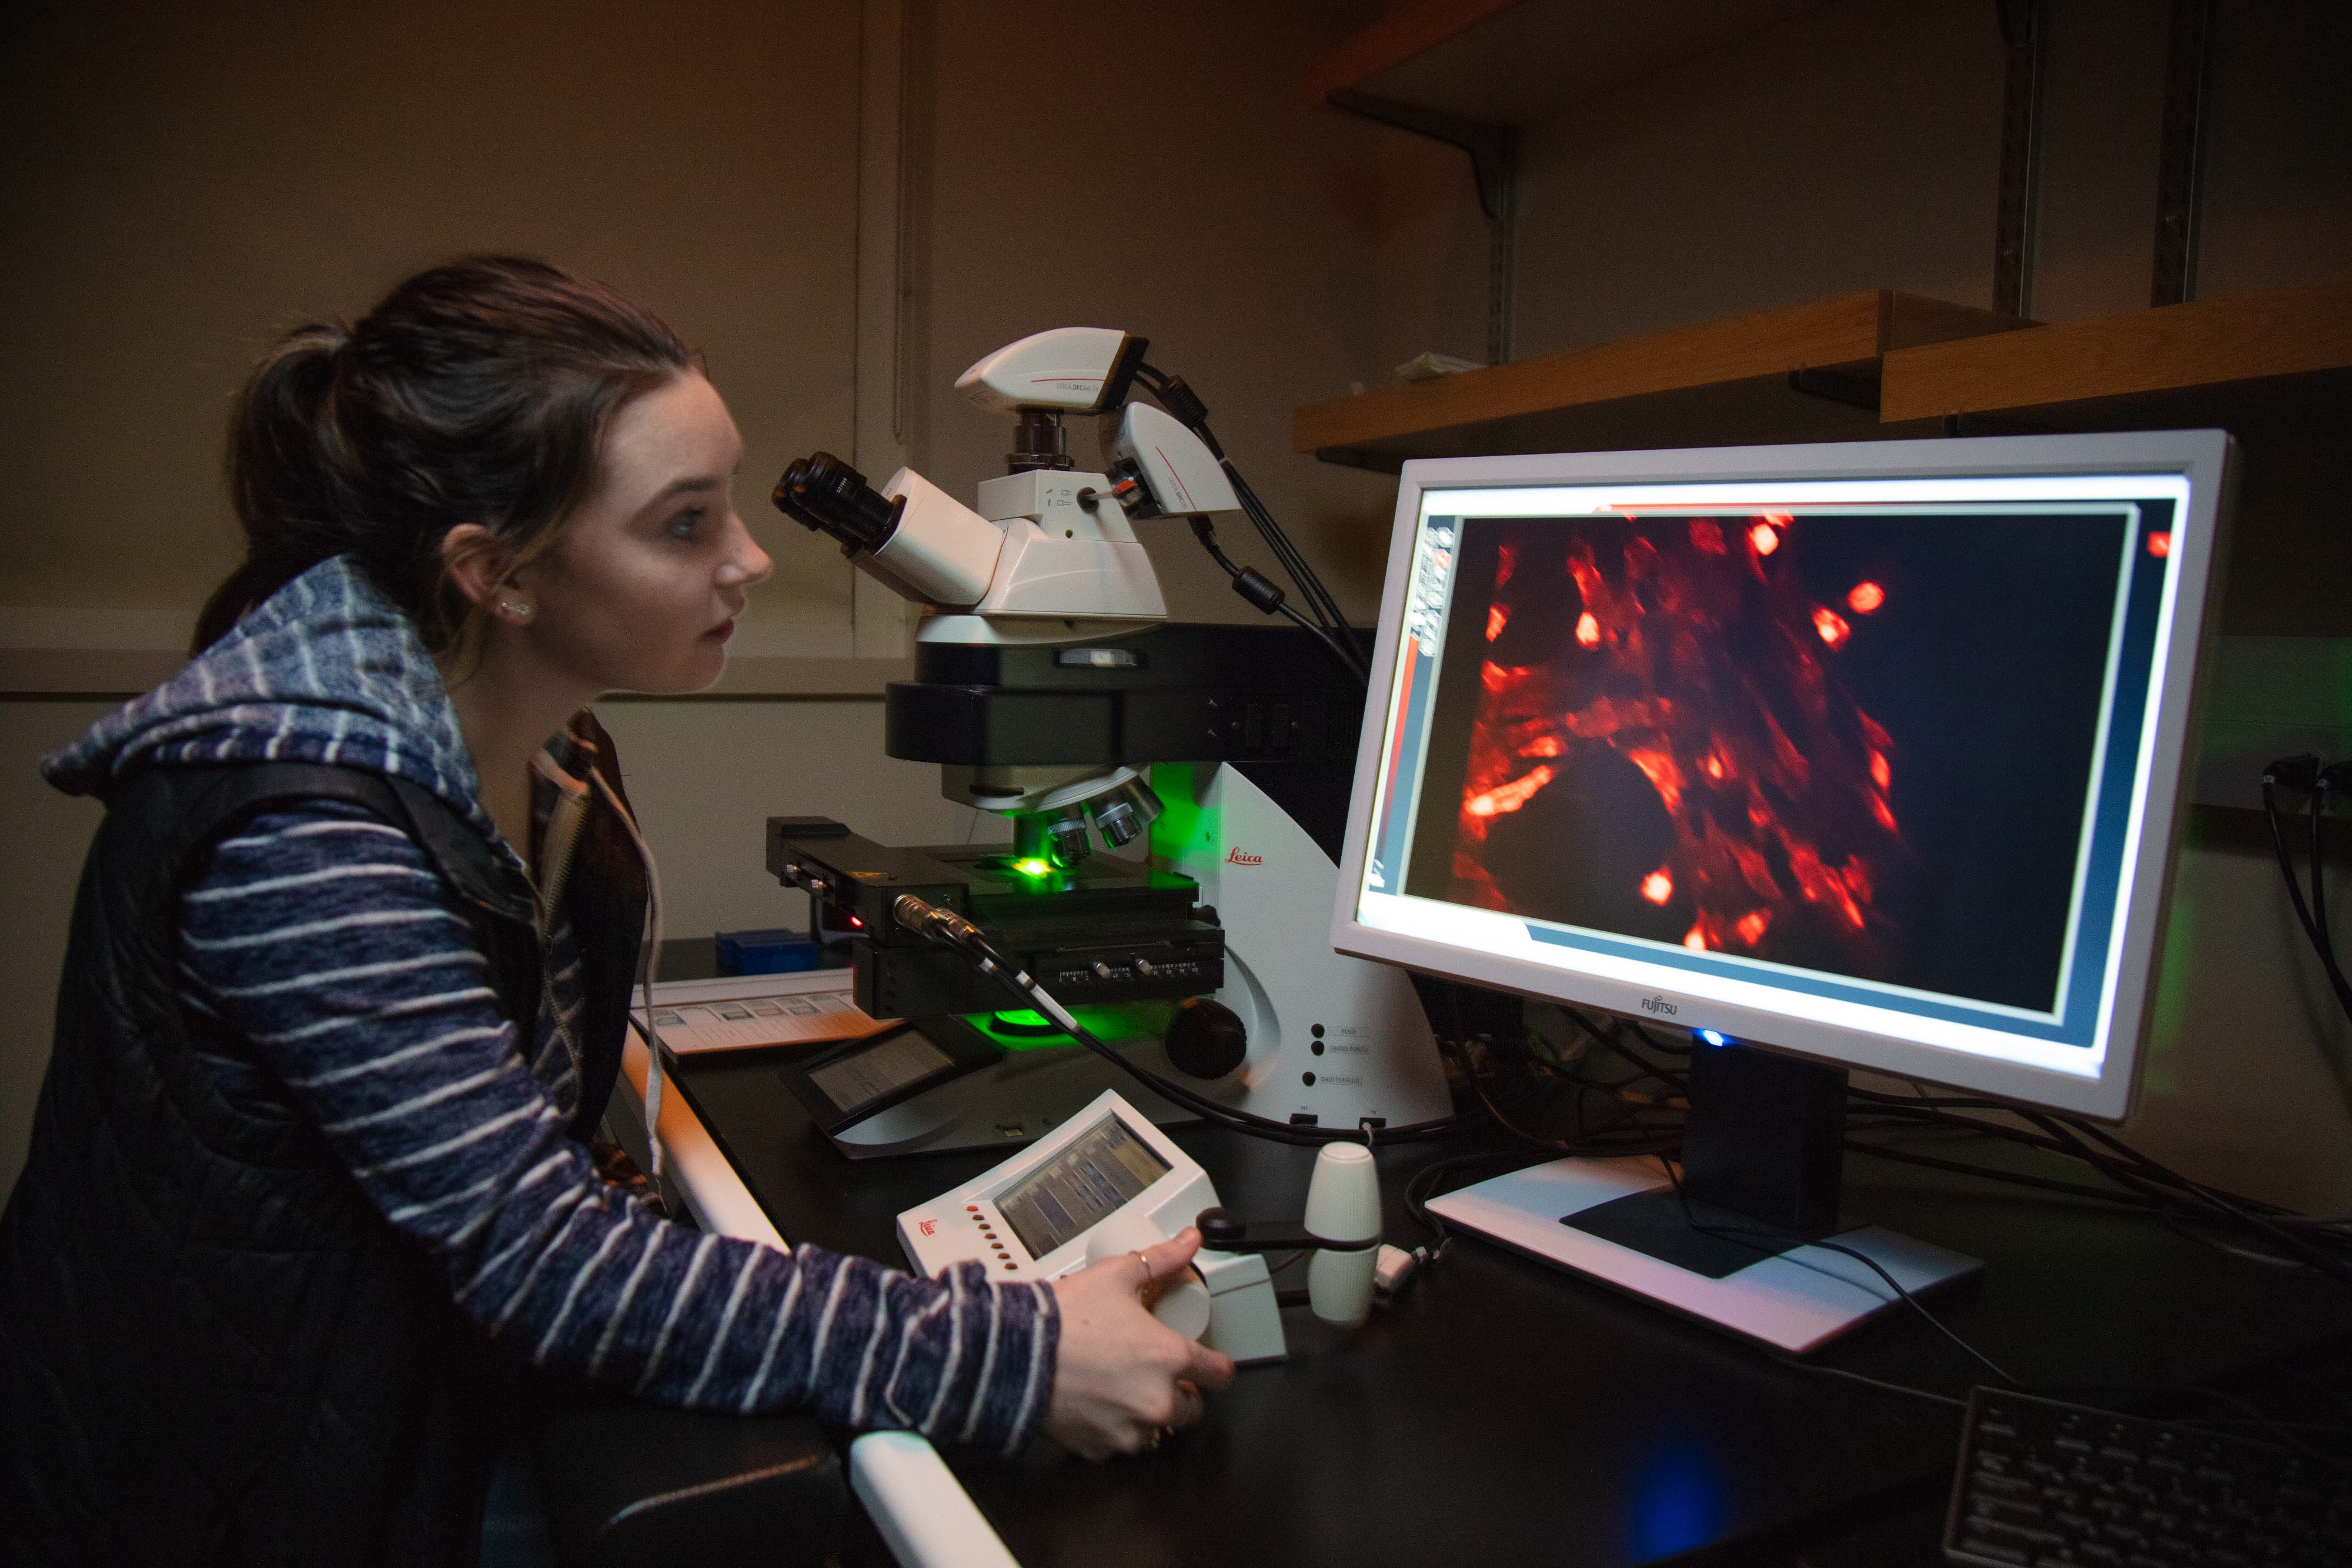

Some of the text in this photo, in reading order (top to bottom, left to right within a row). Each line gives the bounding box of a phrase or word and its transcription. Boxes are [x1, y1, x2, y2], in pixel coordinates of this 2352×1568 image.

[1225, 847, 1262, 866] Leica
[1642, 996, 1677, 1015] FUJITSU
[919, 1219, 938, 1237] Leica
